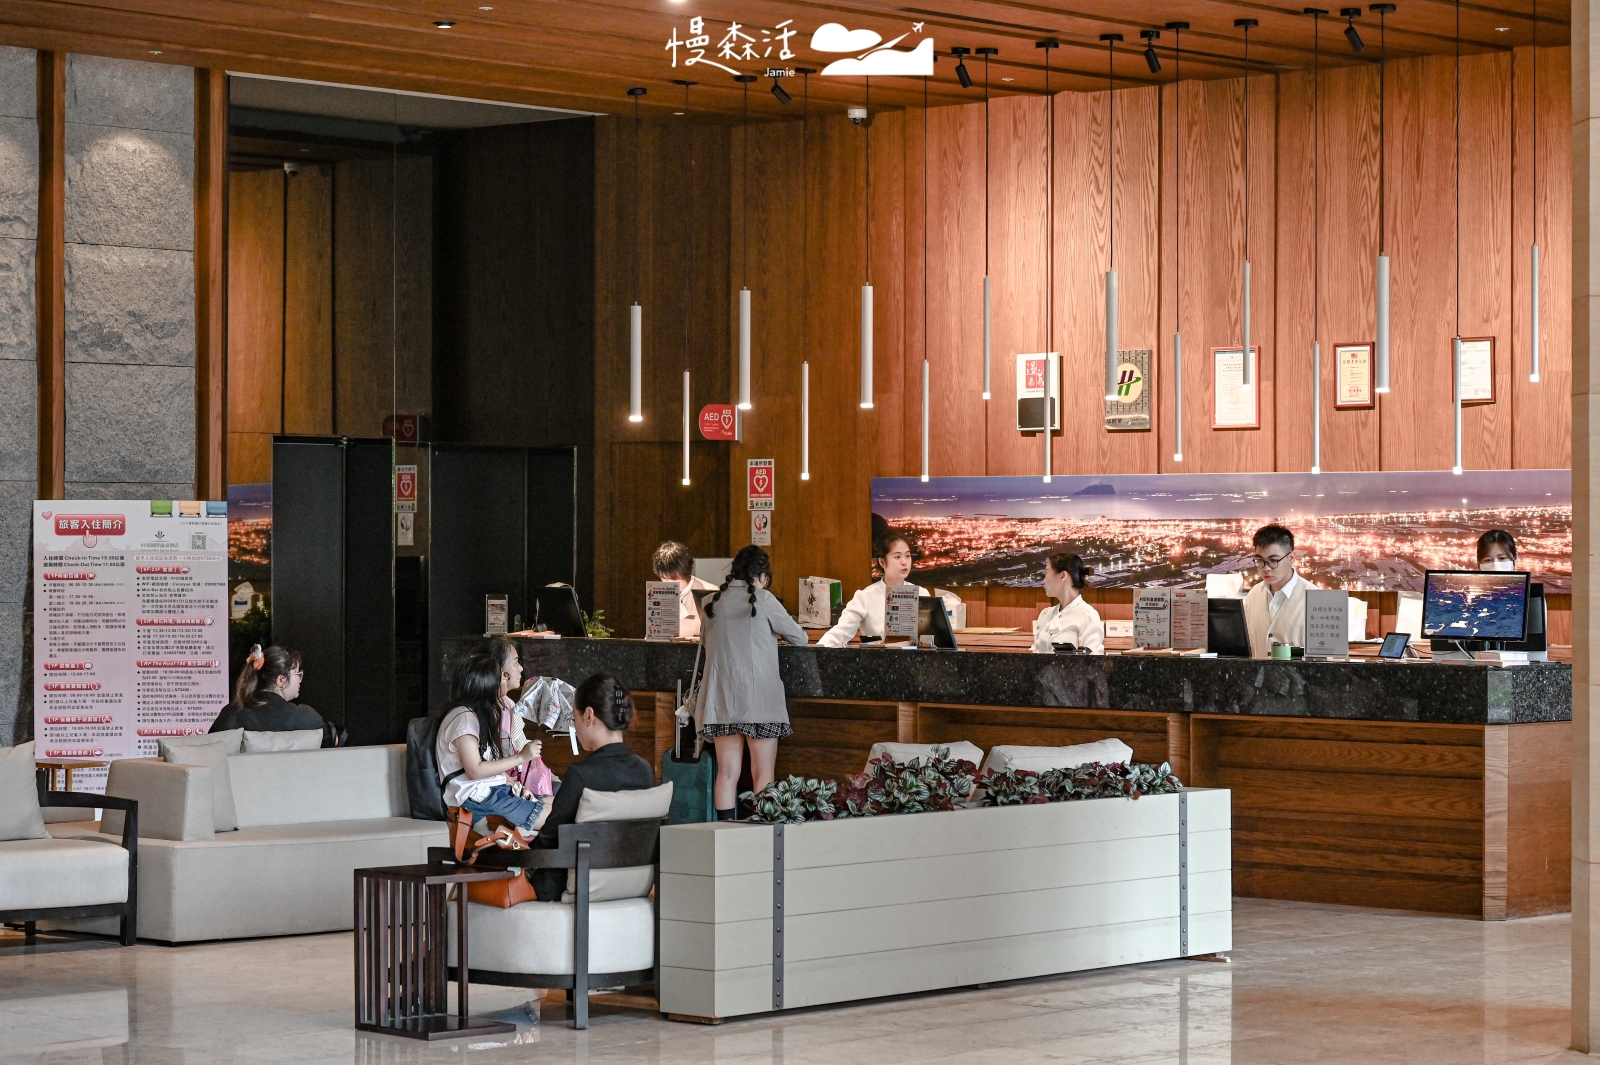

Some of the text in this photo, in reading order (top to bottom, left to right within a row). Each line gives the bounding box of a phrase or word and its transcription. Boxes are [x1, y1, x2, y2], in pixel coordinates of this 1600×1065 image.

[704, 412, 719, 420] AED
[59, 520, 123, 530] 旅客入住簡介
